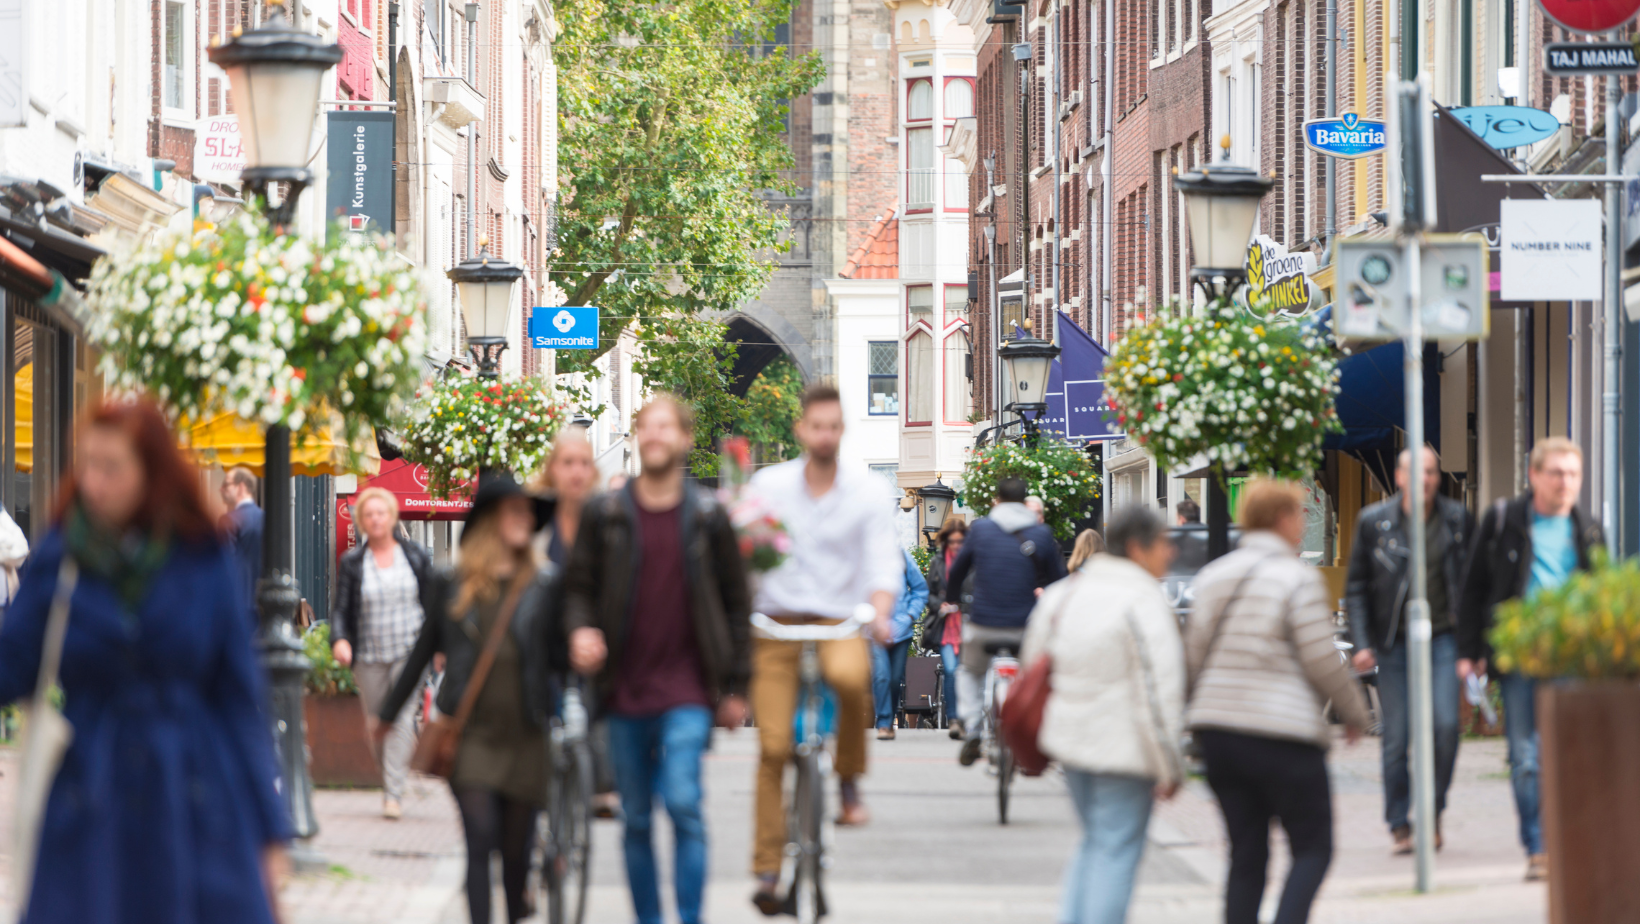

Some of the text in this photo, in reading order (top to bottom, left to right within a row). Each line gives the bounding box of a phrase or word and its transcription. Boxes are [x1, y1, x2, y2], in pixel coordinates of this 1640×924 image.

[1551, 48, 1637, 67] TAJ MAHAL
[1315, 128, 1386, 145] Bavaria
[352, 125, 367, 208] Kunstgalerie
[1264, 245, 1276, 261] de
[1511, 241, 1592, 251] NUMBER NINE
[1265, 256, 1303, 283] groene
[536, 336, 594, 346] Samsonite
